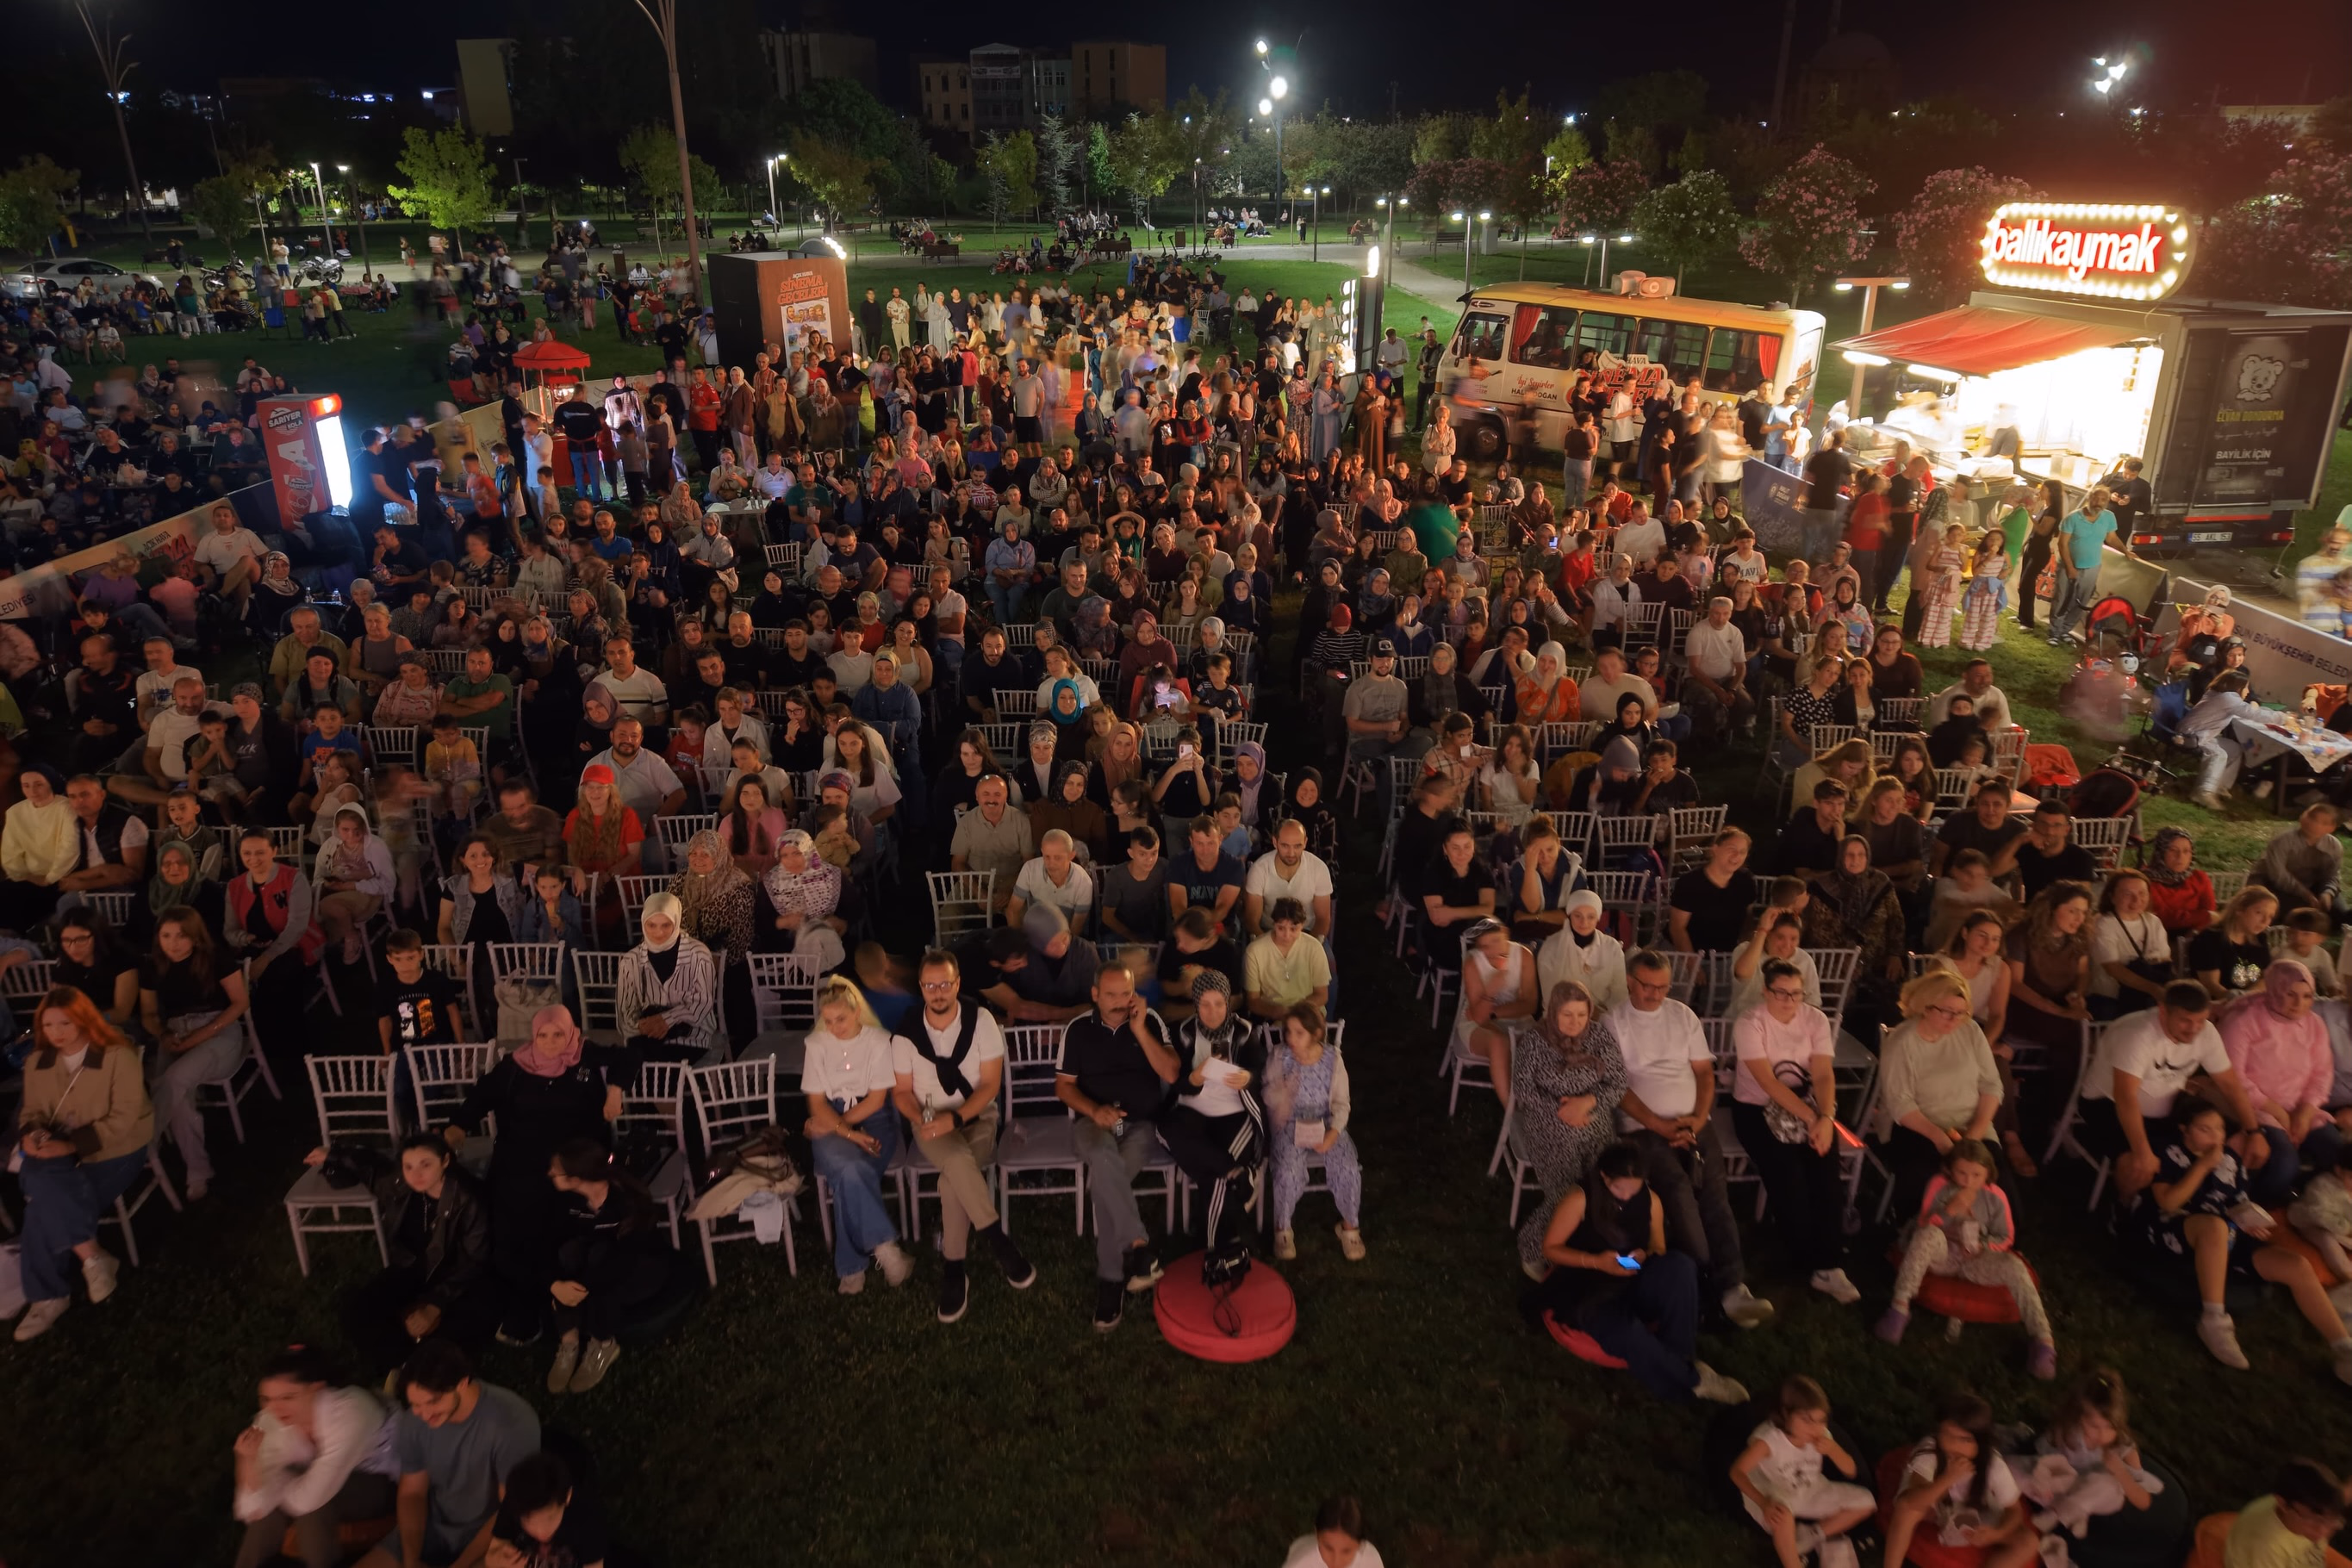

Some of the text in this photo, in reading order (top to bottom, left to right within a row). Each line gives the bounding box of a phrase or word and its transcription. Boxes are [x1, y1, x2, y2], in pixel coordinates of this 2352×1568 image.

[780, 275, 824, 293] SİNEMA
[777, 282, 828, 305] GECELERİ
[268, 410, 302, 428] SARIYER
[287, 420, 303, 430] KOLA
[2216, 448, 2272, 460] BAYİLİK İÇİN
[2253, 633, 2316, 665] BÜYÜKŞEHİR
[273, 889, 288, 909] W
